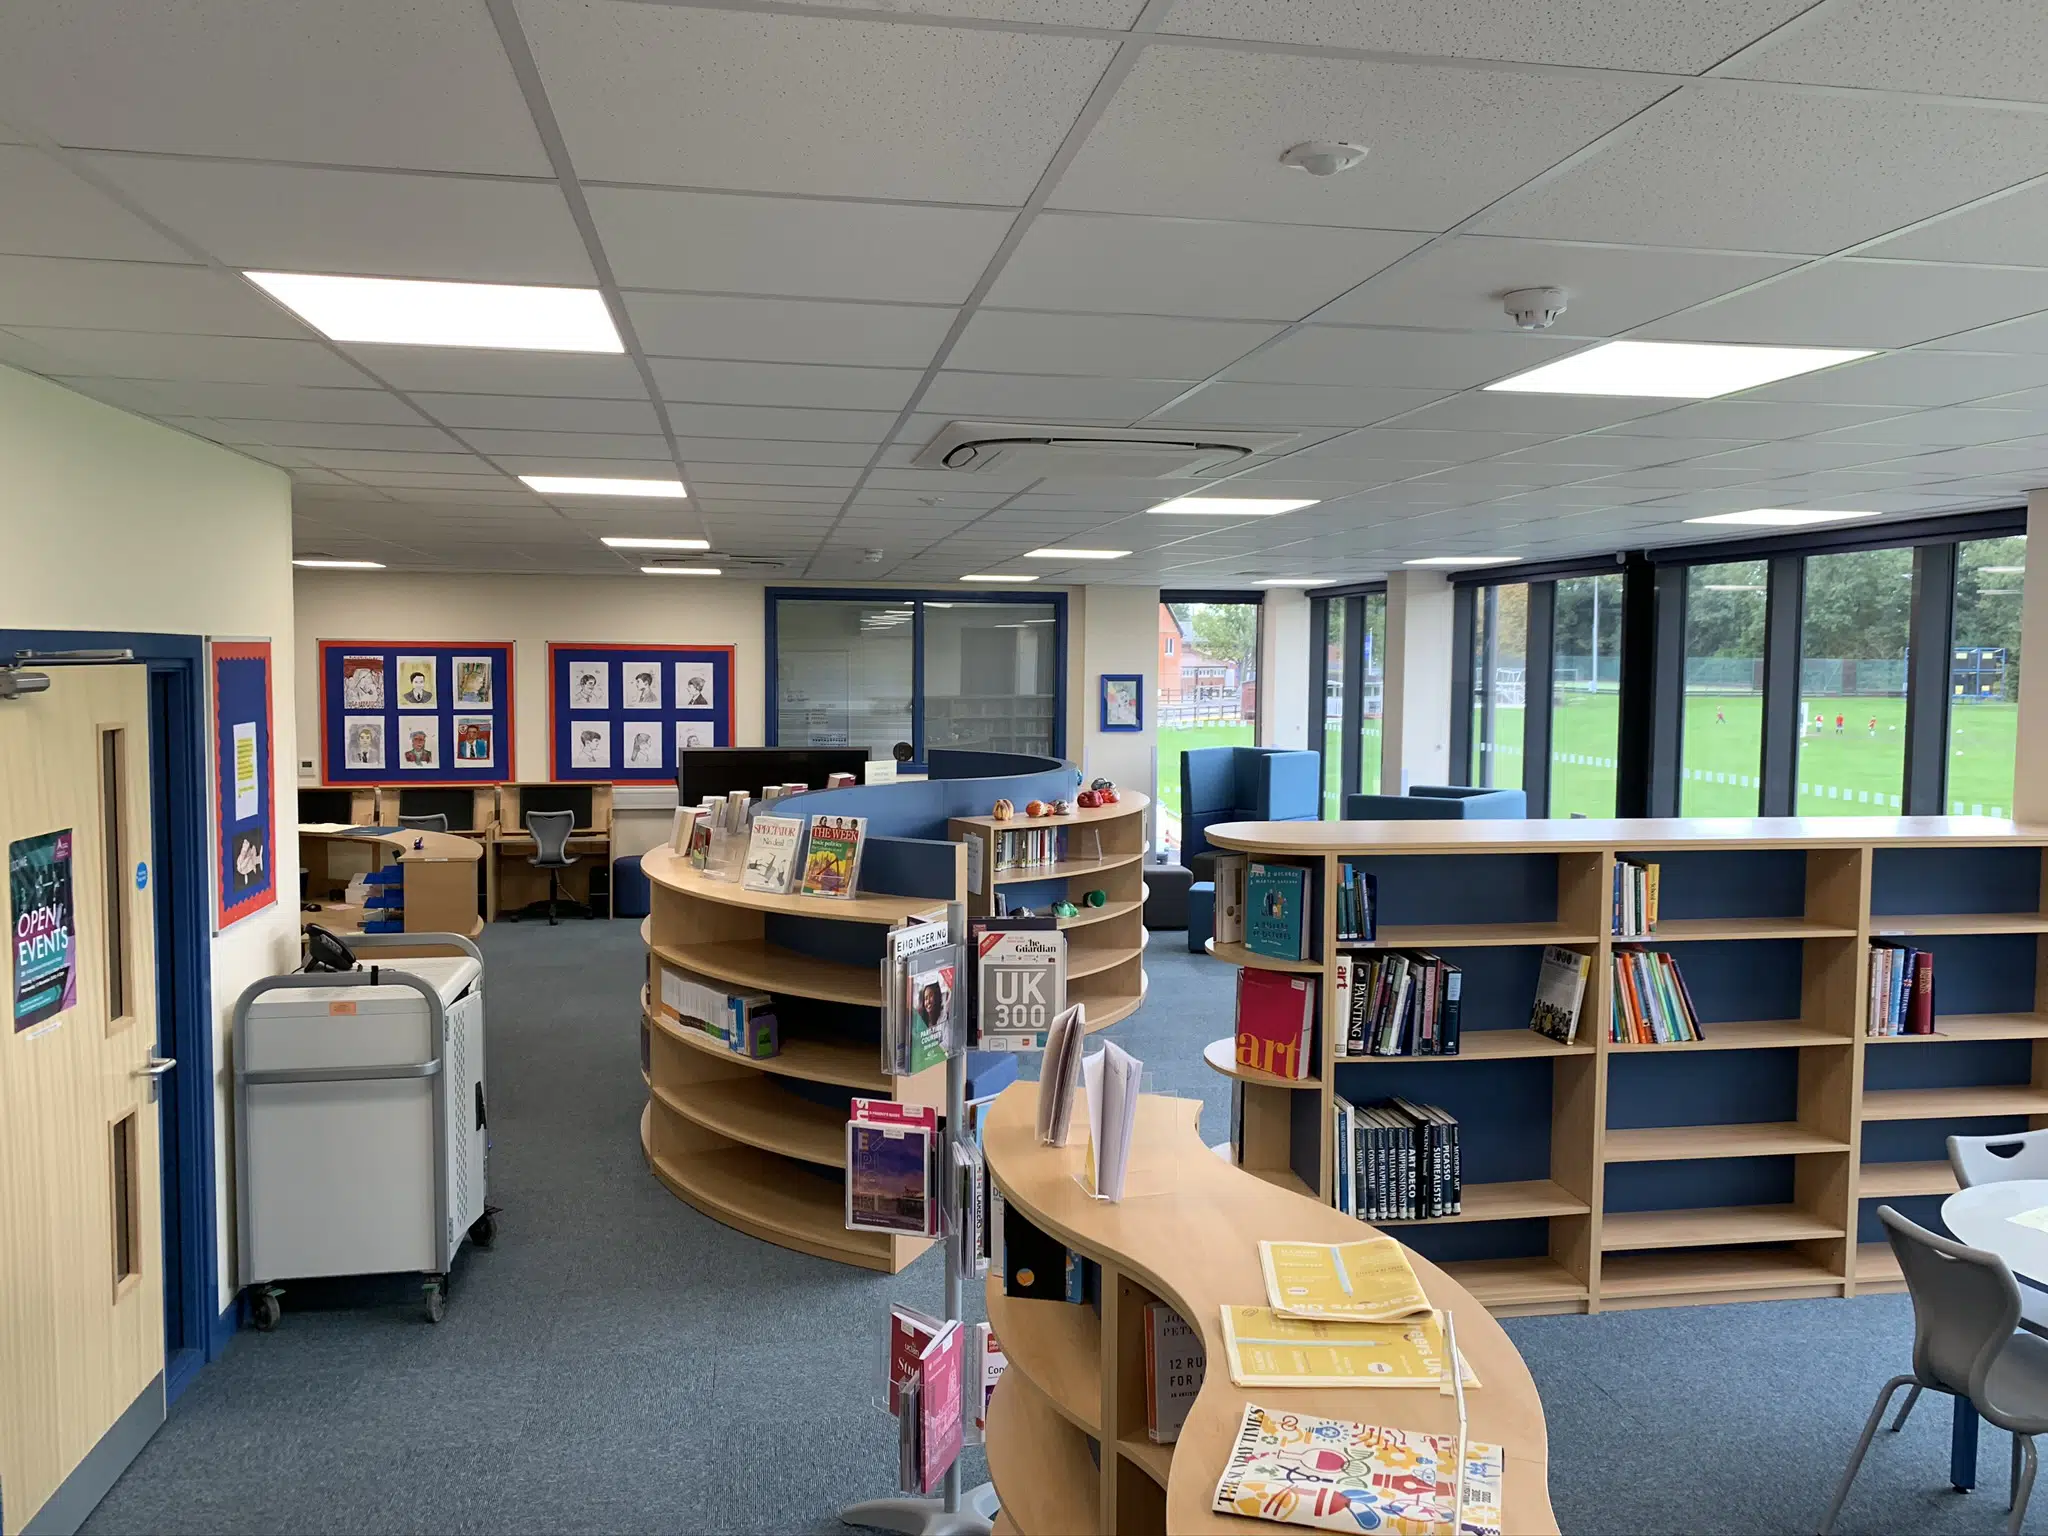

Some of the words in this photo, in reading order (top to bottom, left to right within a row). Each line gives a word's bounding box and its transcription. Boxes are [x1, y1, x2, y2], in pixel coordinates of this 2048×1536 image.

[754, 823, 796, 837] SPECTATOR
[813, 827, 832, 839] THE
[832, 828, 859, 841] WEEK
[18, 903, 57, 938] OPEN
[18, 926, 69, 966] EVENTS
[1015, 943, 1057, 953] Guardian
[995, 971, 1047, 1005] UK
[1337, 965, 1348, 990] art
[994, 1004, 1047, 1028] 300
[1351, 983, 1367, 1038] PAINTING
[1236, 1032, 1301, 1081] art
[1356, 1149, 1364, 1174] MONET
[1367, 1149, 1376, 1189] CONSTABLE
[1388, 1148, 1397, 1179] WILLIAM
[1408, 1149, 1416, 1167] ART
[1442, 1145, 1451, 1181] PICASSO
[1408, 1172, 1416, 1198] DECO
[1433, 1147, 1441, 1203] SURREALISTS
[1389, 1180, 1397, 1209] MORRIS
[1169, 1358, 1182, 1370] 12
[1170, 1374, 1193, 1387] FOR
[1240, 1406, 1265, 1446] TIMES
[1227, 1446, 1254, 1480] SUNDAY
[1218, 1480, 1241, 1505] THE
